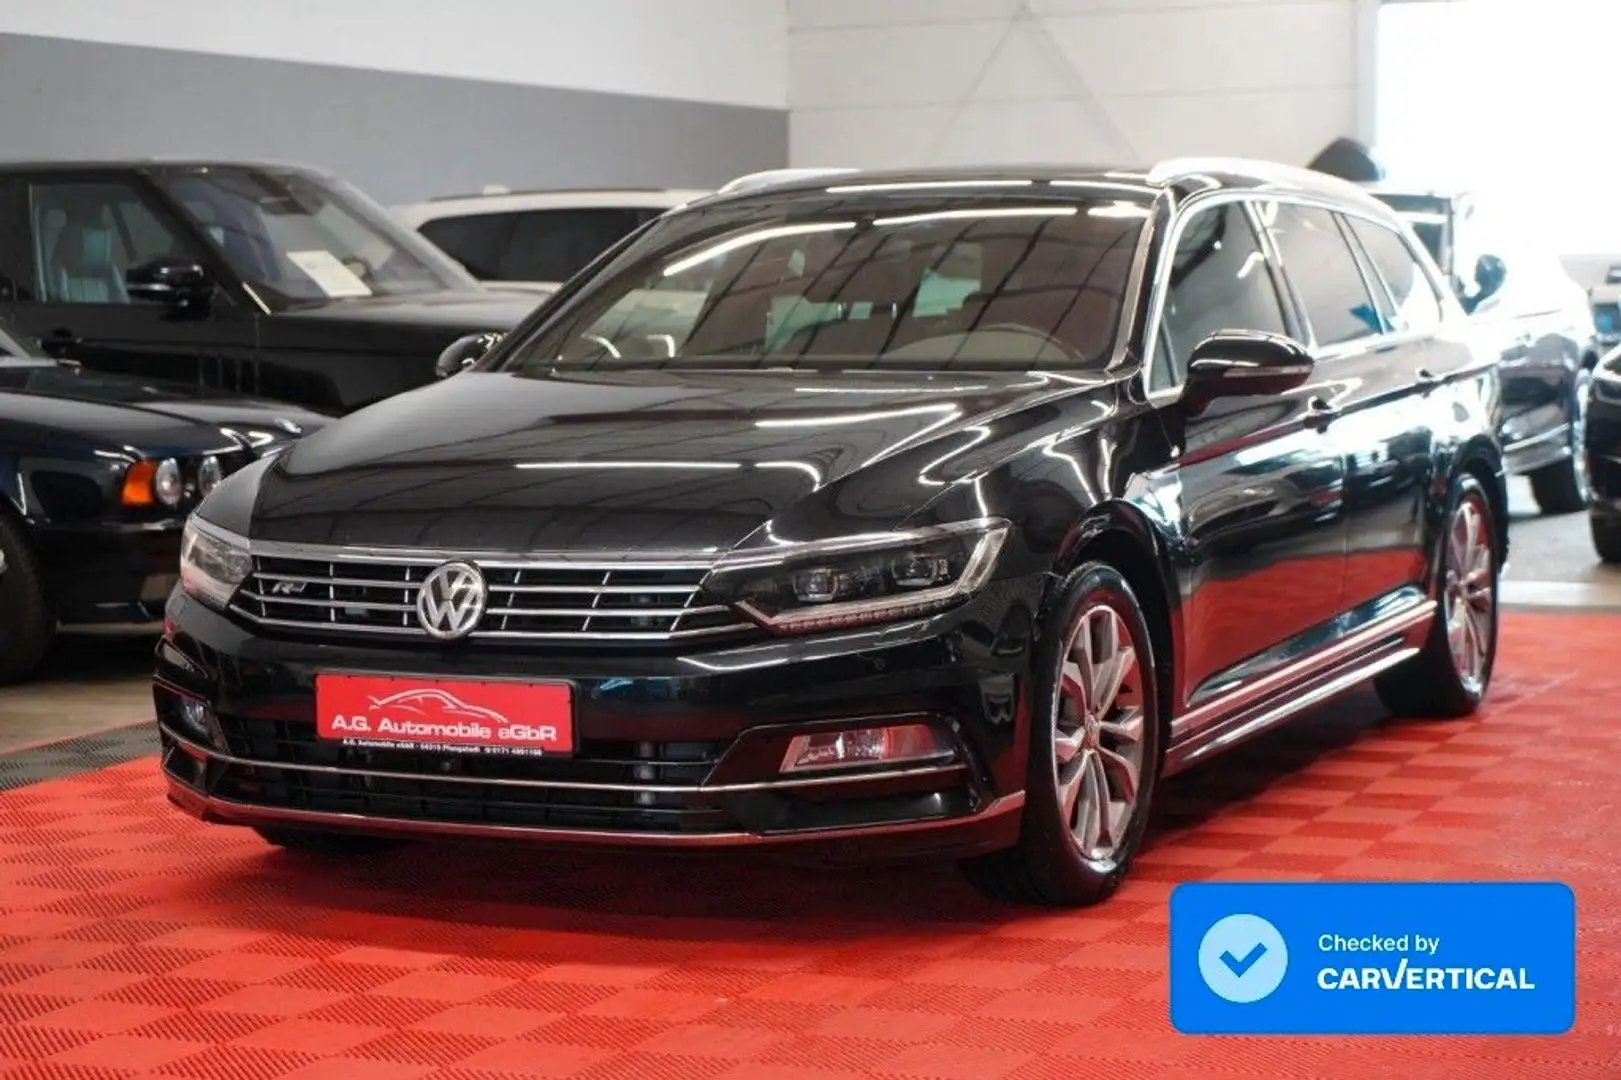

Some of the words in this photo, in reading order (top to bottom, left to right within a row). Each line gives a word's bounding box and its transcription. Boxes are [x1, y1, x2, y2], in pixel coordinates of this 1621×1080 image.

[331, 714, 372, 732] A.G.
[377, 717, 492, 740] Automobile
[498, 724, 557, 741] eGbR
